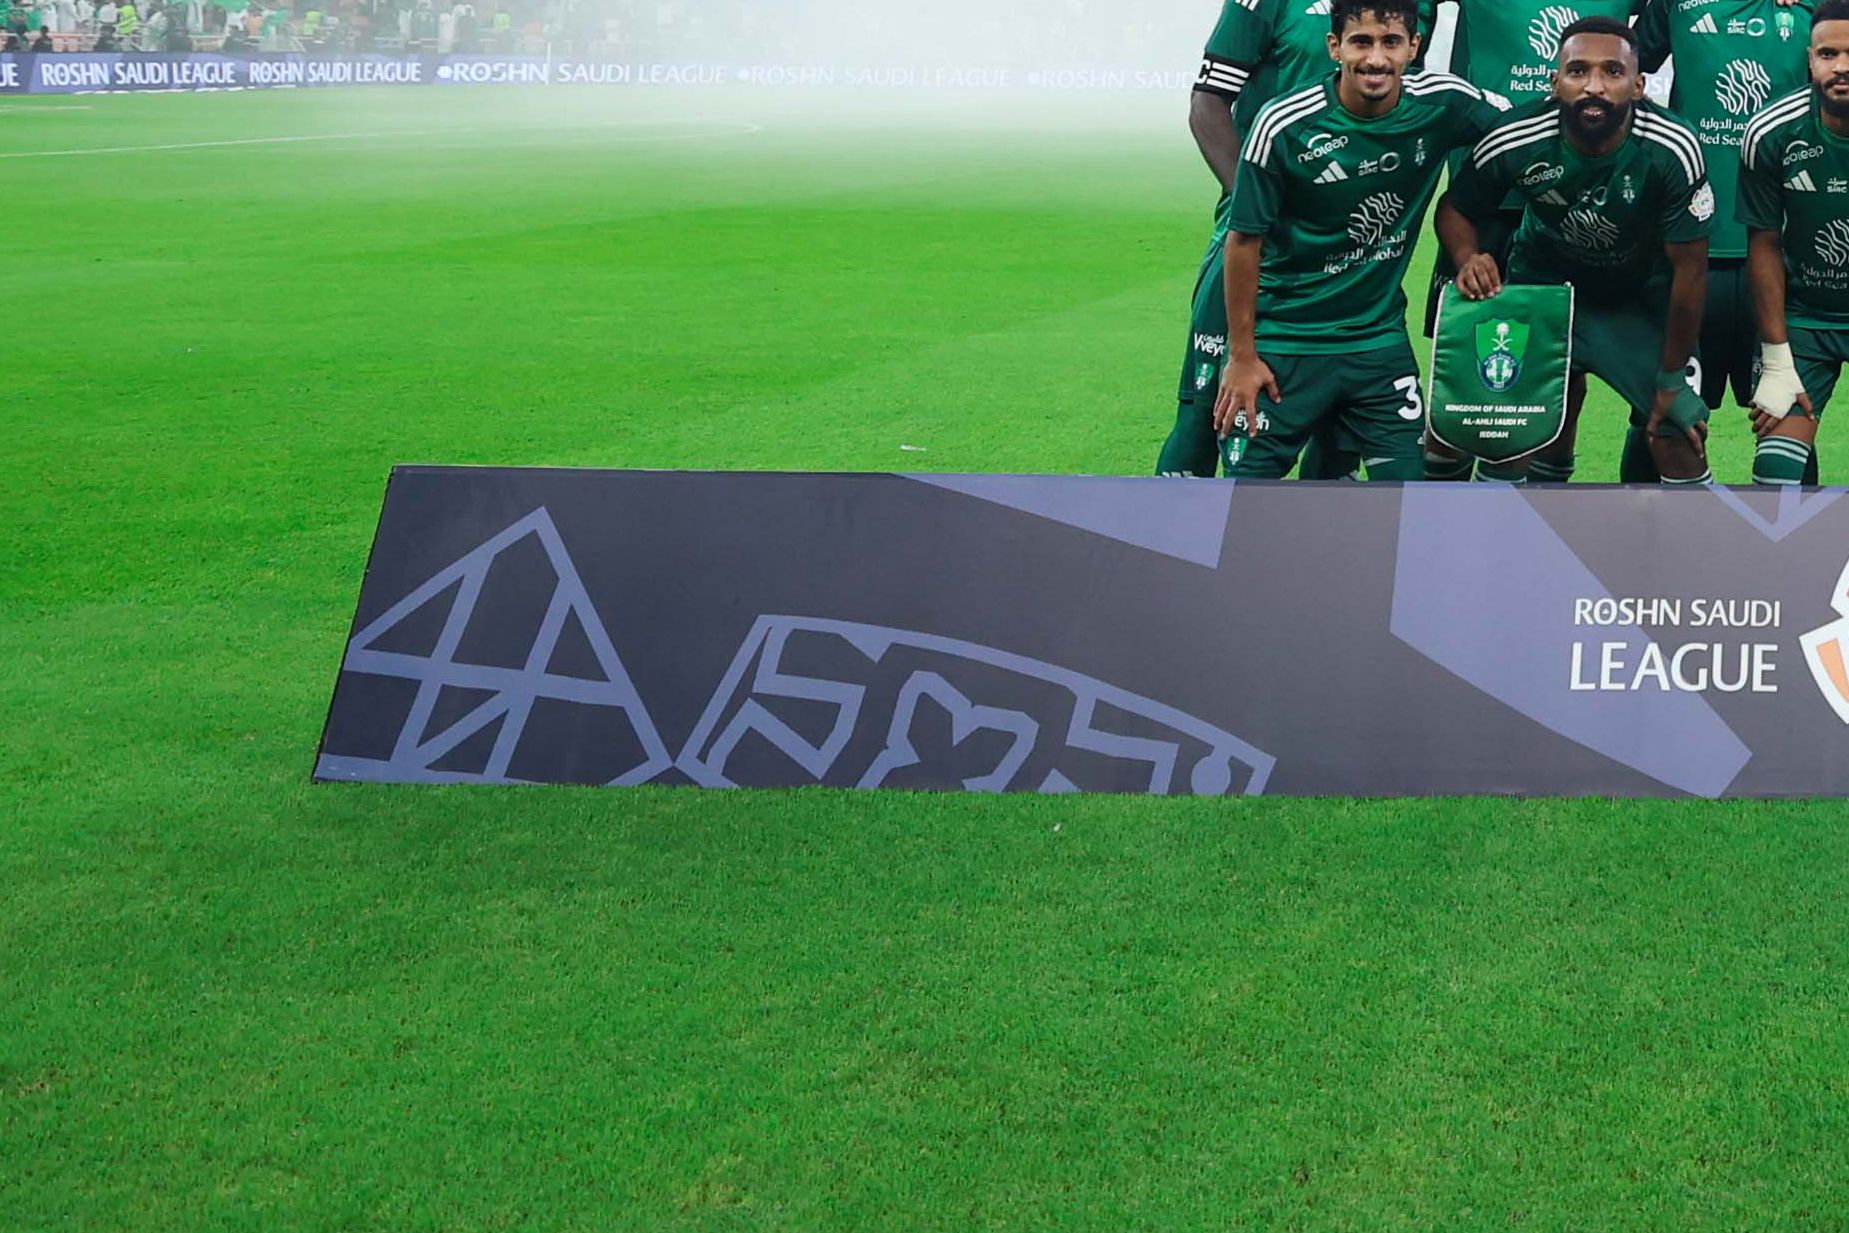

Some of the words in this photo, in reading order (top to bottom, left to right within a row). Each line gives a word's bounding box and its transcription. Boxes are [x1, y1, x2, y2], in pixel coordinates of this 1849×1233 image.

[41, 62, 109, 86] ROSHN
[116, 62, 168, 84] SAUDI
[173, 62, 235, 84] LEAGUE
[250, 62, 303, 83] ROSHN
[308, 62, 350, 83] SAUDI
[355, 62, 421, 82] LEAGUE
[453, 62, 548, 82] ROSHN
[558, 63, 630, 83] SAUDI
[1510, 80, 1533, 91] Red
[1700, 133, 1720, 144] Red
[1297, 135, 1349, 164] neoleap
[1445, 404, 1481, 412] KINGDOM
[1483, 405, 1494, 413] OF
[1517, 418, 1527, 426] FC
[1574, 598, 1681, 626] ROSHN
[1690, 599, 1781, 627] SAUDI
[1570, 642, 1779, 692] LEAGUE
